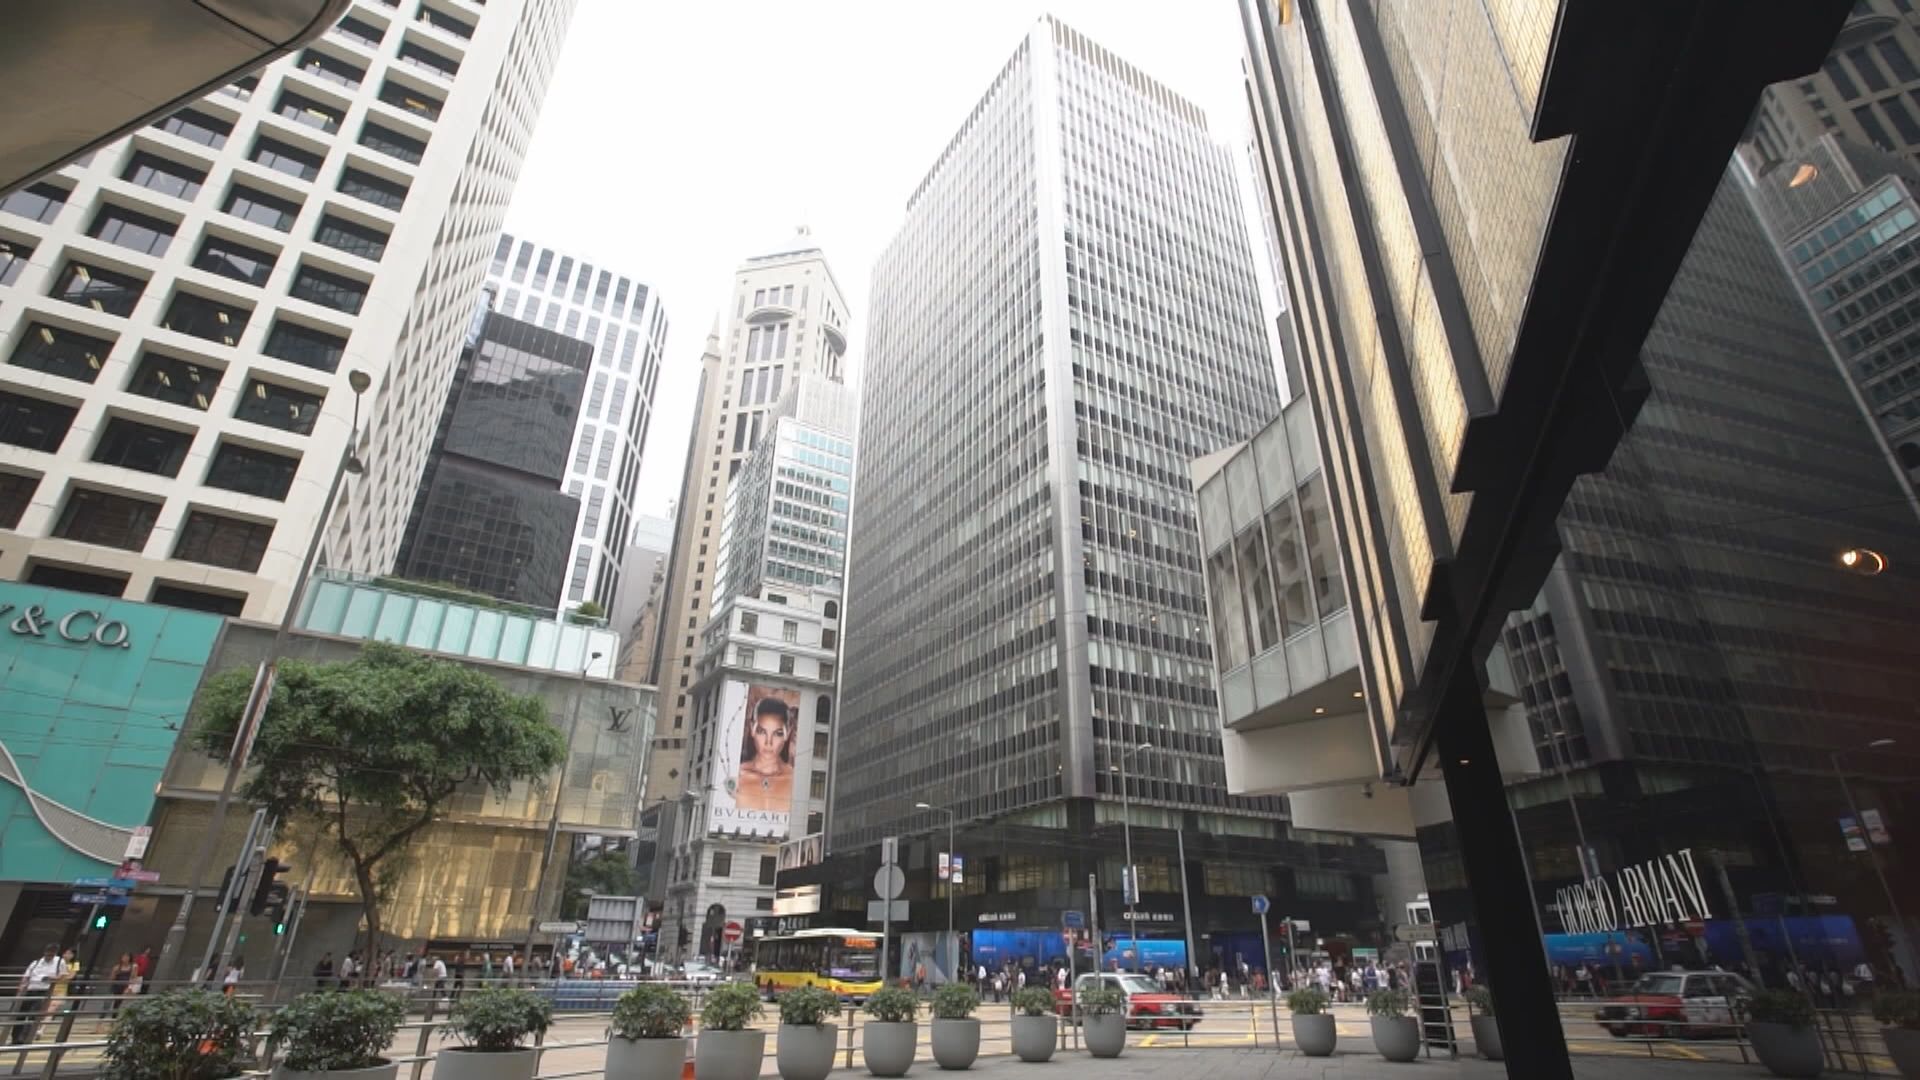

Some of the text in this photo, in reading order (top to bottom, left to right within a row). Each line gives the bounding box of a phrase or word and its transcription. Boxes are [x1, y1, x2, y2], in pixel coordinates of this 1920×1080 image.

[10, 605, 53, 637] &
[714, 806, 789, 824] BVLGARI
[1556, 848, 1713, 936] GIORGIO ARMANI
